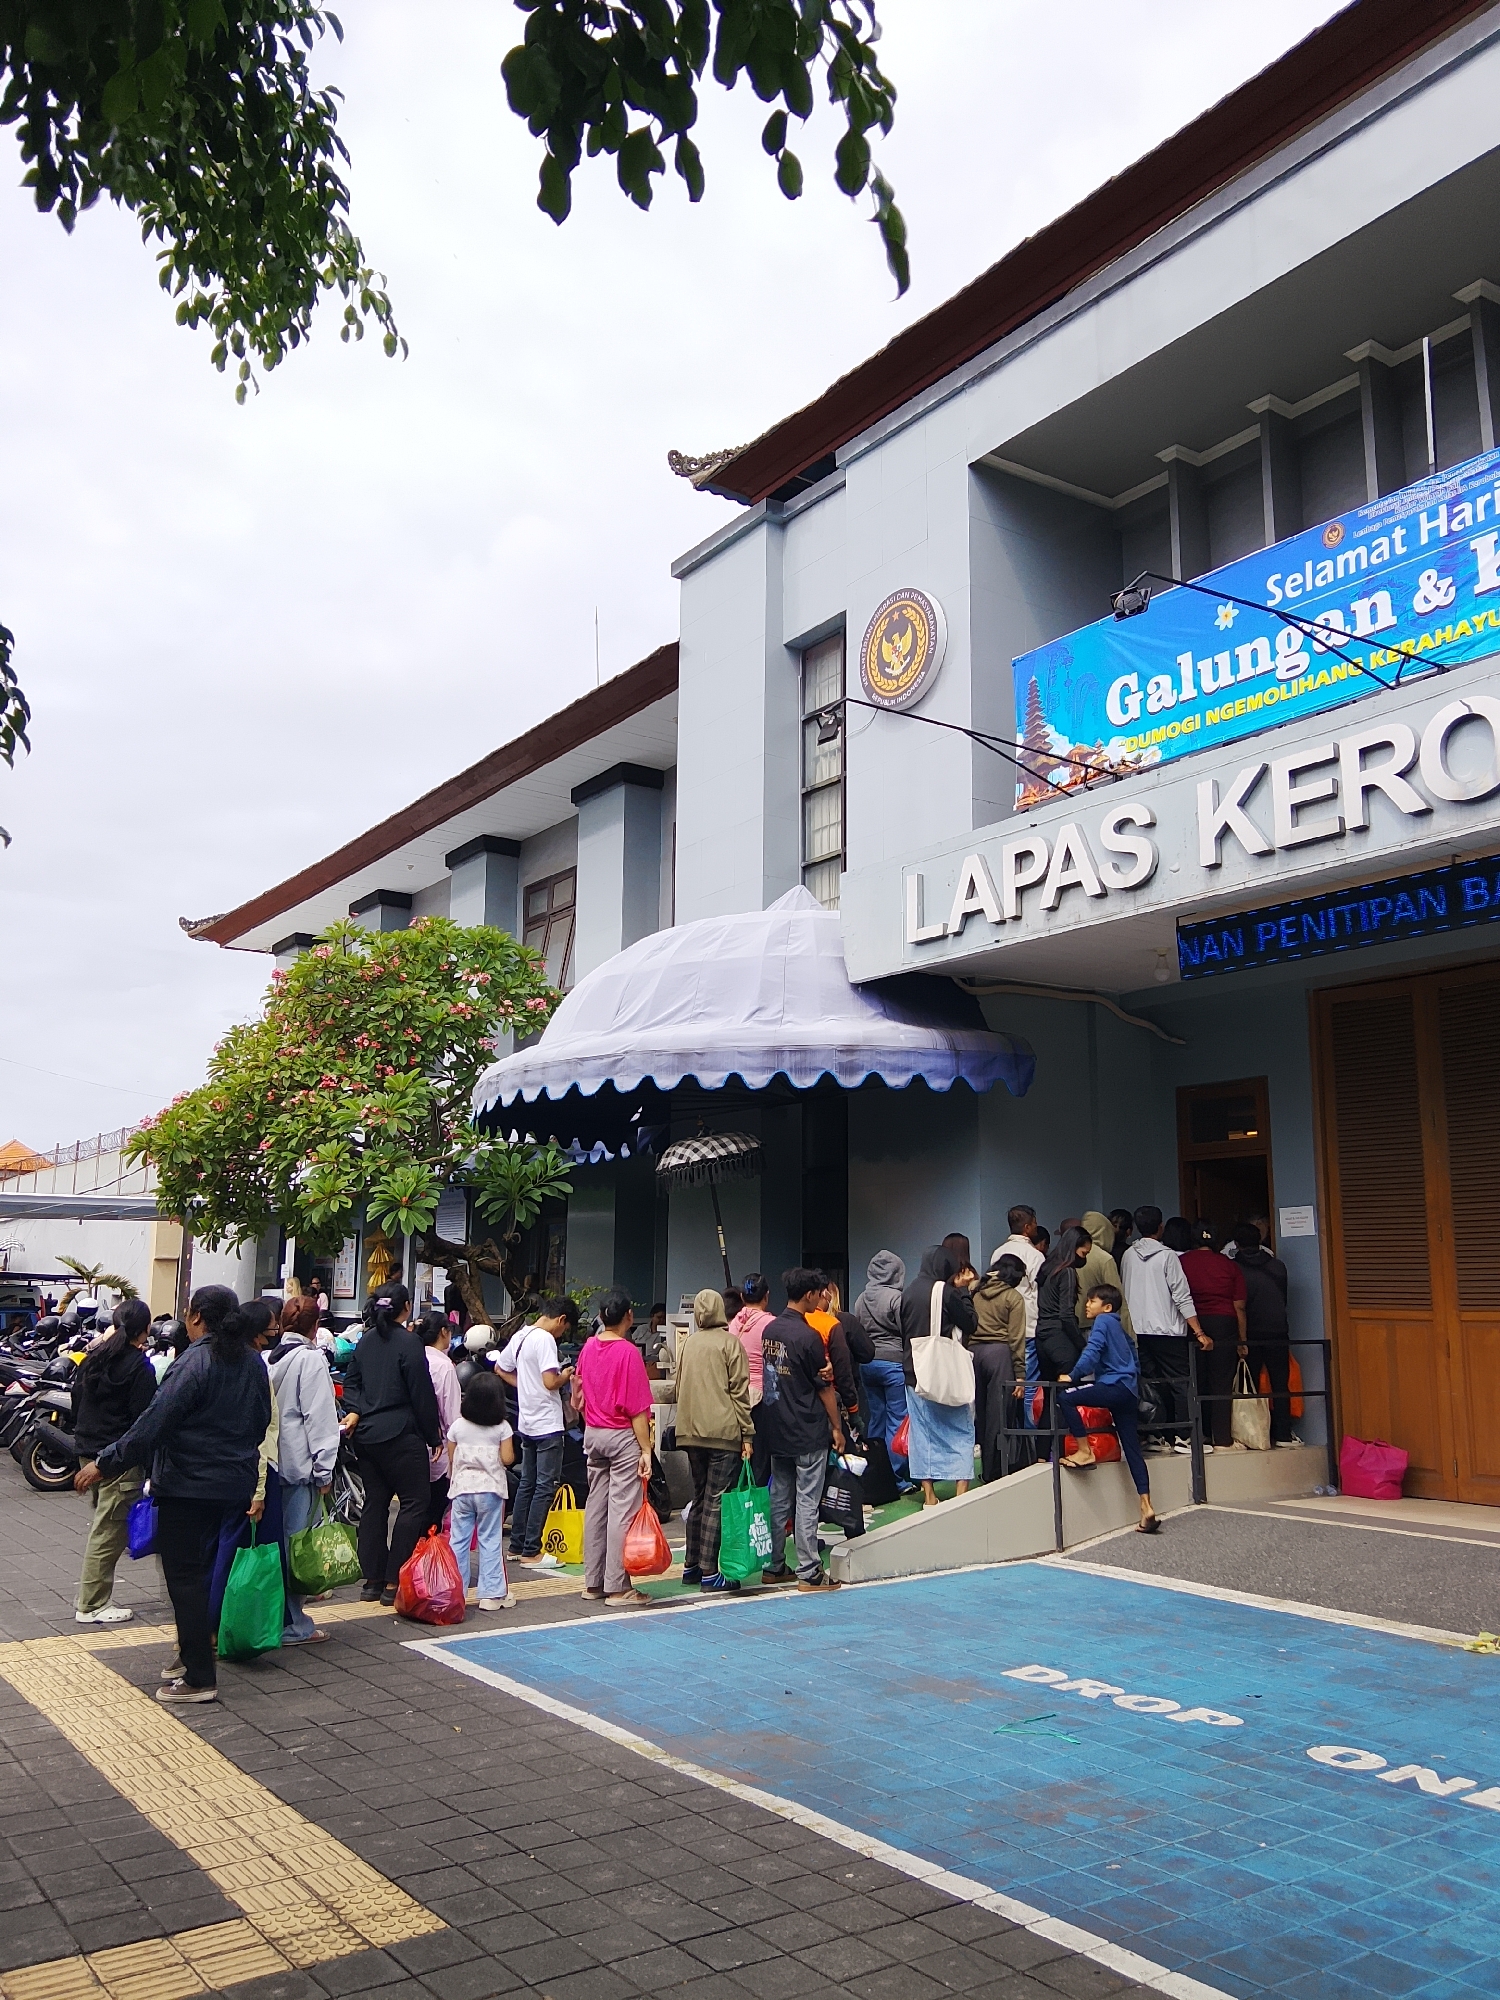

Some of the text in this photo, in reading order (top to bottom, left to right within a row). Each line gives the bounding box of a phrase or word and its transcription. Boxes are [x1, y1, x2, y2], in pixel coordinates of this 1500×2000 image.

[1265, 479, 1500, 608] Selamat Hari
[896, 591, 910, 601] DAN
[1105, 589, 1398, 728] Galungan
[1412, 567, 1457, 618] &
[896, 670, 926, 704] INDONESIA
[1205, 657, 1364, 726] NGEMOLIHANG
[906, 695, 1500, 945] LAPAS KERO
[1254, 884, 1449, 952] PENITIPAN
[1000, 1664, 1244, 1726] DROP
